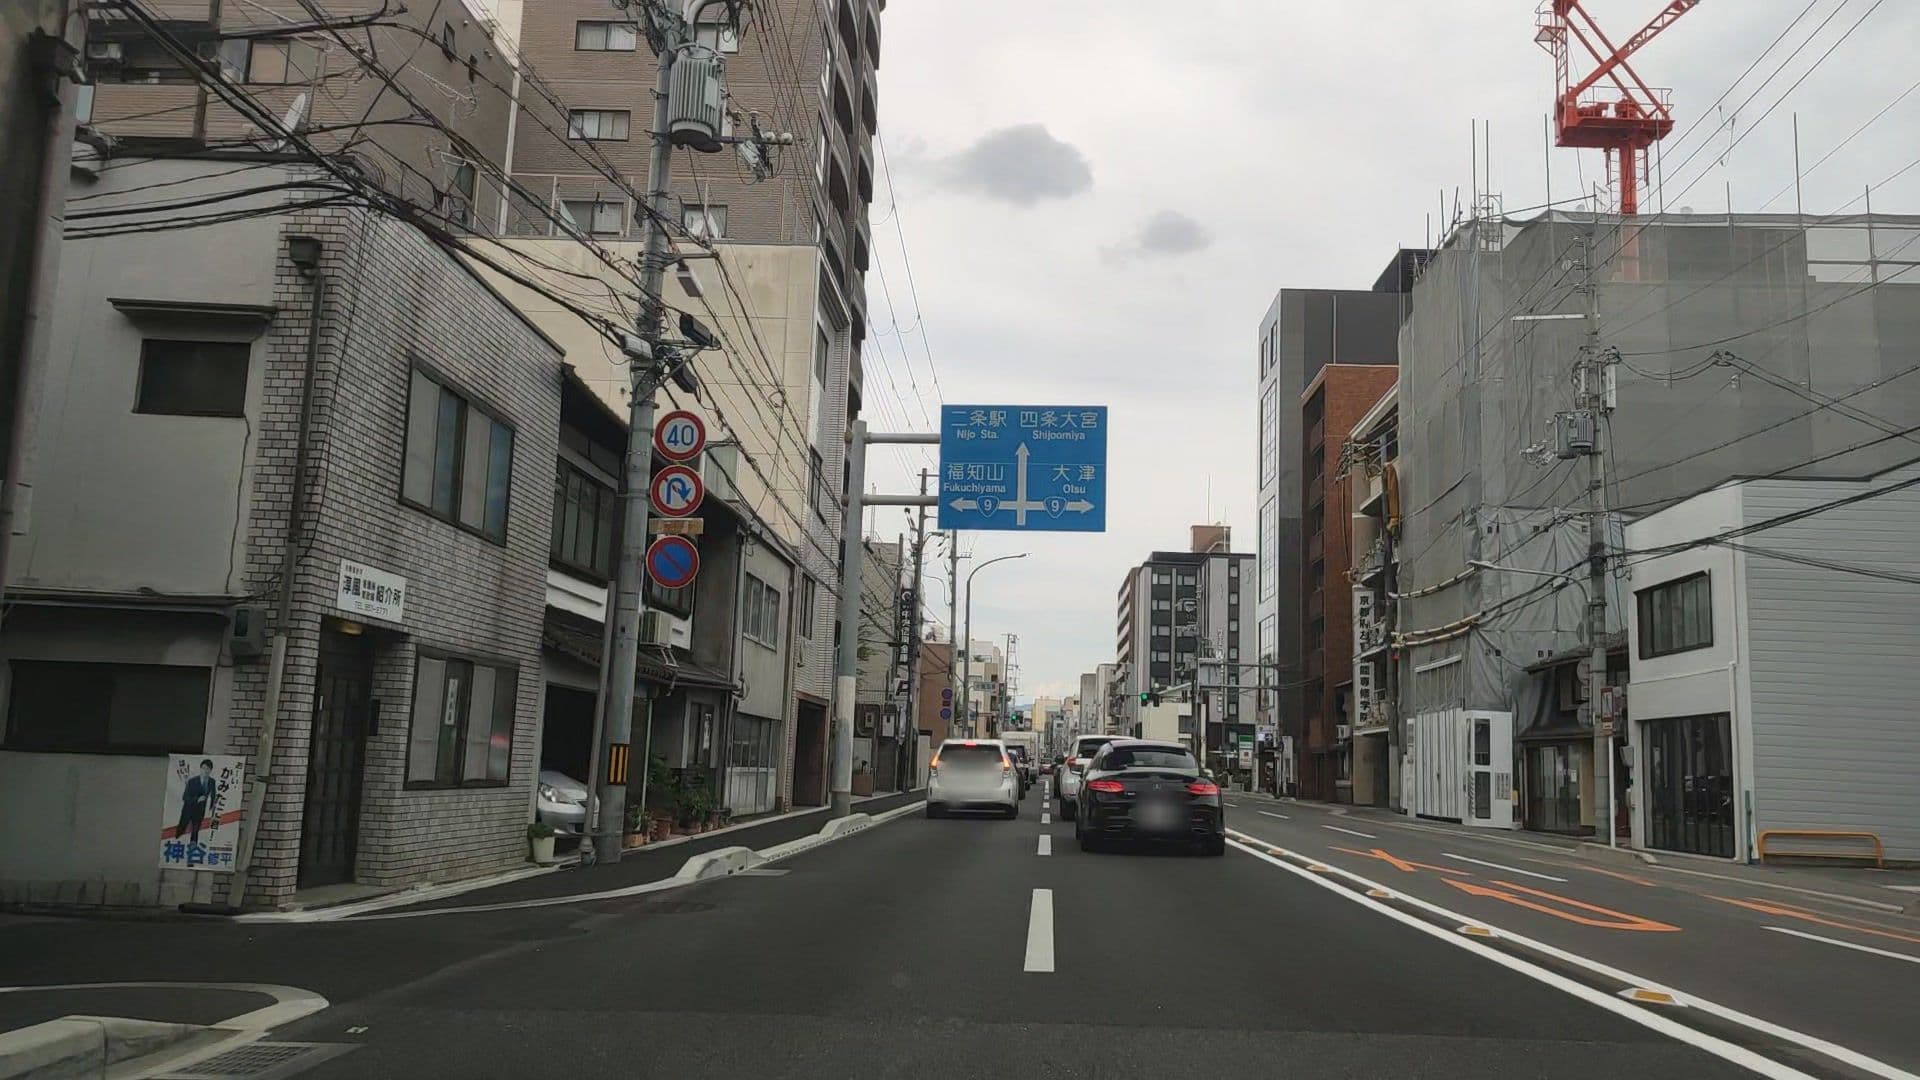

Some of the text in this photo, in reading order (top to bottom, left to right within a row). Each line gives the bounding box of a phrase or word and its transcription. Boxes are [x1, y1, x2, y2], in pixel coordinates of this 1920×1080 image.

[951, 410, 1007, 427] 二条駅
[1020, 410, 1098, 428] 四条大宮
[667, 424, 694, 446] 40
[957, 430, 999, 440] Nijo Sta.
[948, 463, 1004, 481] 福知山
[1052, 464, 1096, 482] 大津
[943, 483, 1006, 494] Fukuchiyama
[1062, 484, 1086, 494] Otsu
[983, 499, 993, 511] 9
[1050, 499, 1060, 512] 9
[376, 585, 401, 608] 紹介所
